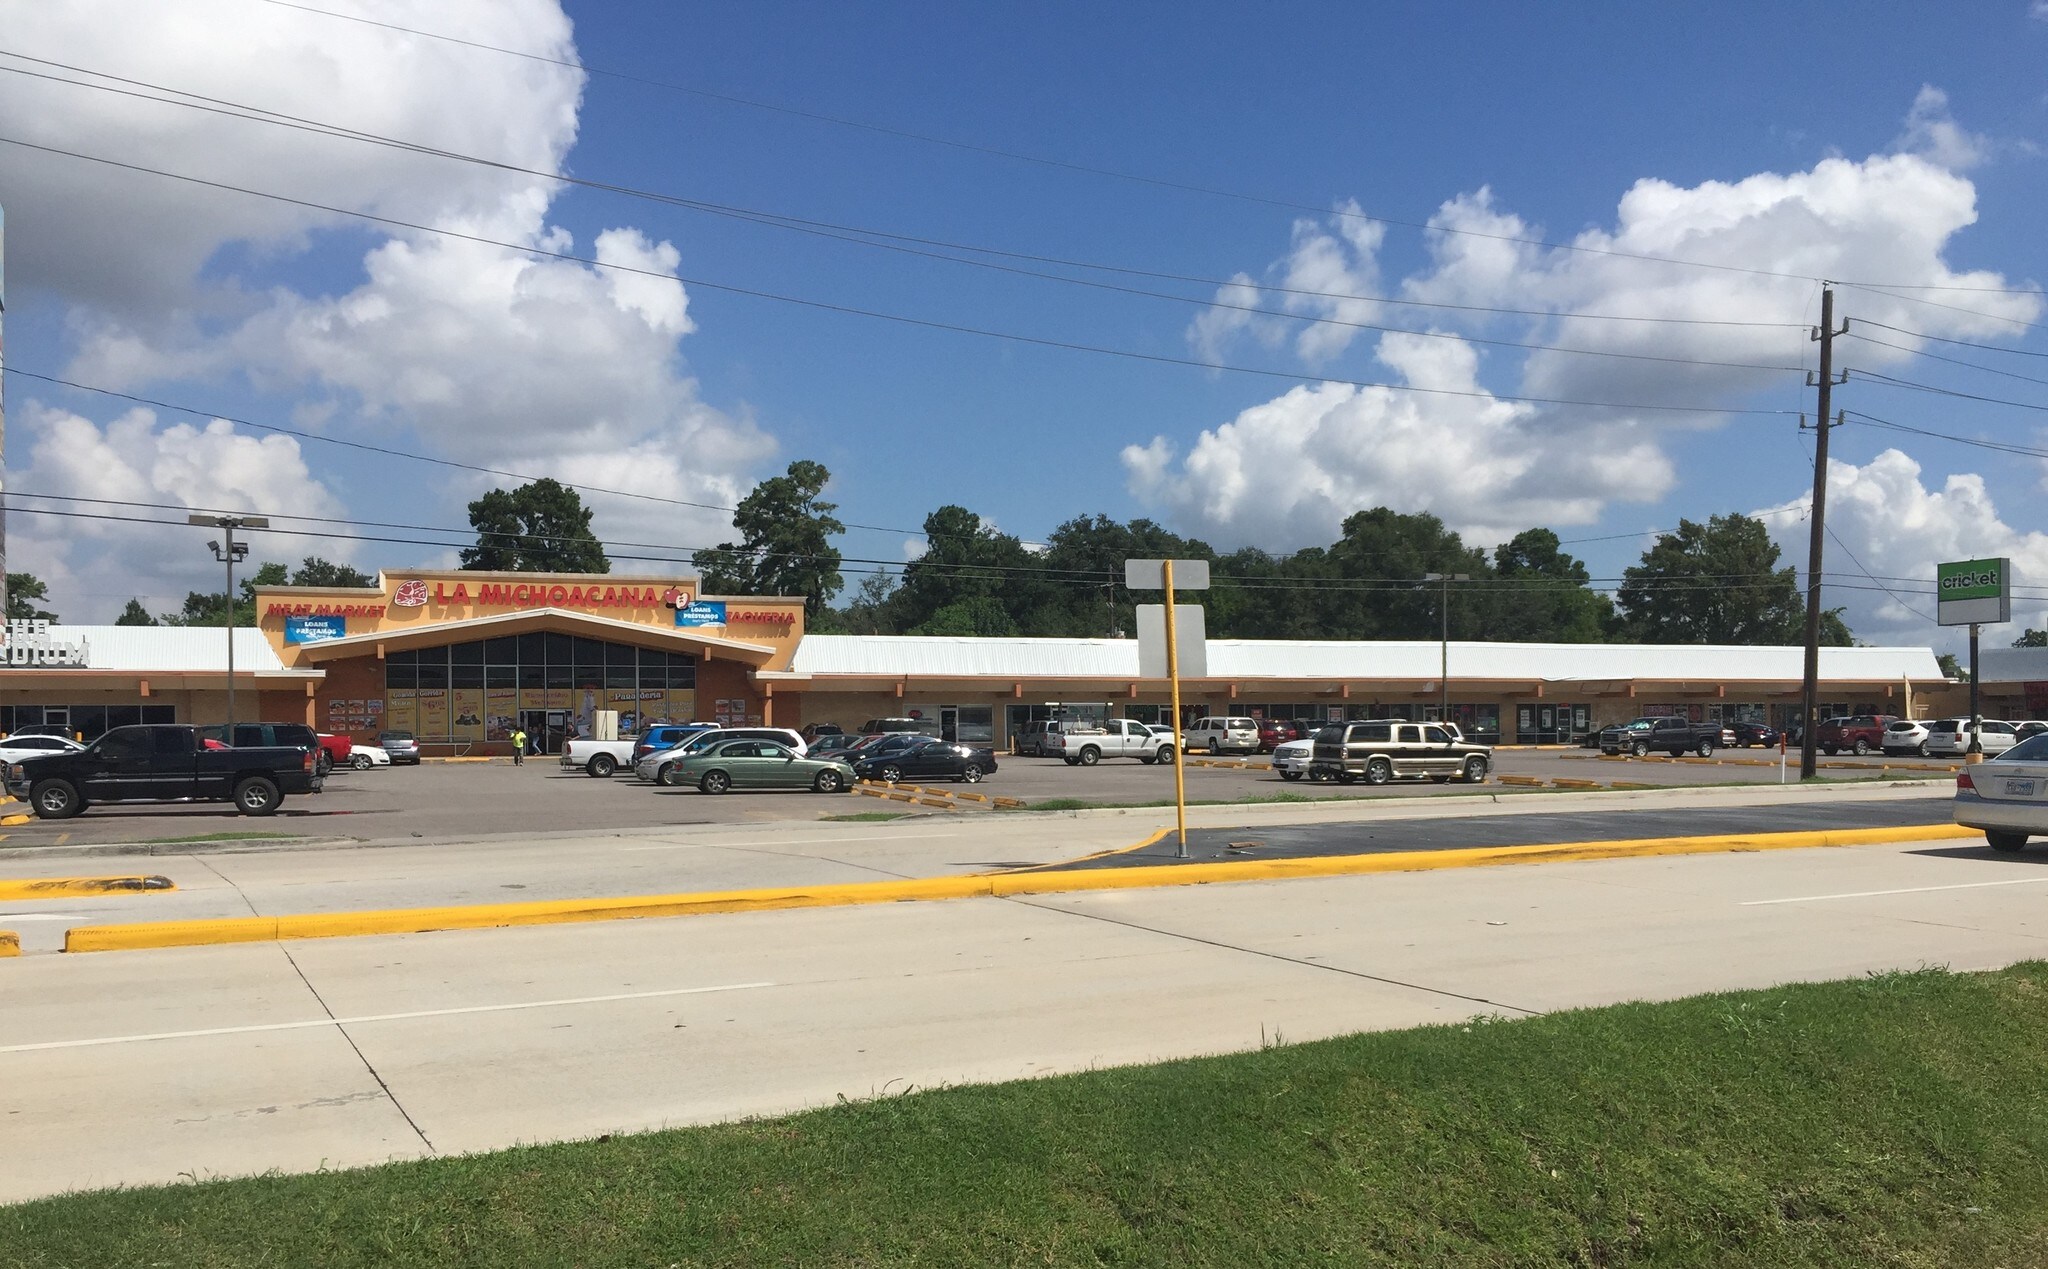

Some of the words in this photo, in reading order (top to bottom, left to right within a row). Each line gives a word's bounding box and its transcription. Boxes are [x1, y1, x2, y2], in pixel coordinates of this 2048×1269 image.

[1942, 569, 1997, 590] cricket
[437, 583, 470, 605] LA
[479, 583, 660, 608] MICHOACANA
[268, 603, 312, 617] MEAT
[315, 604, 386, 618] MARKET
[6, 618, 50, 642] HE
